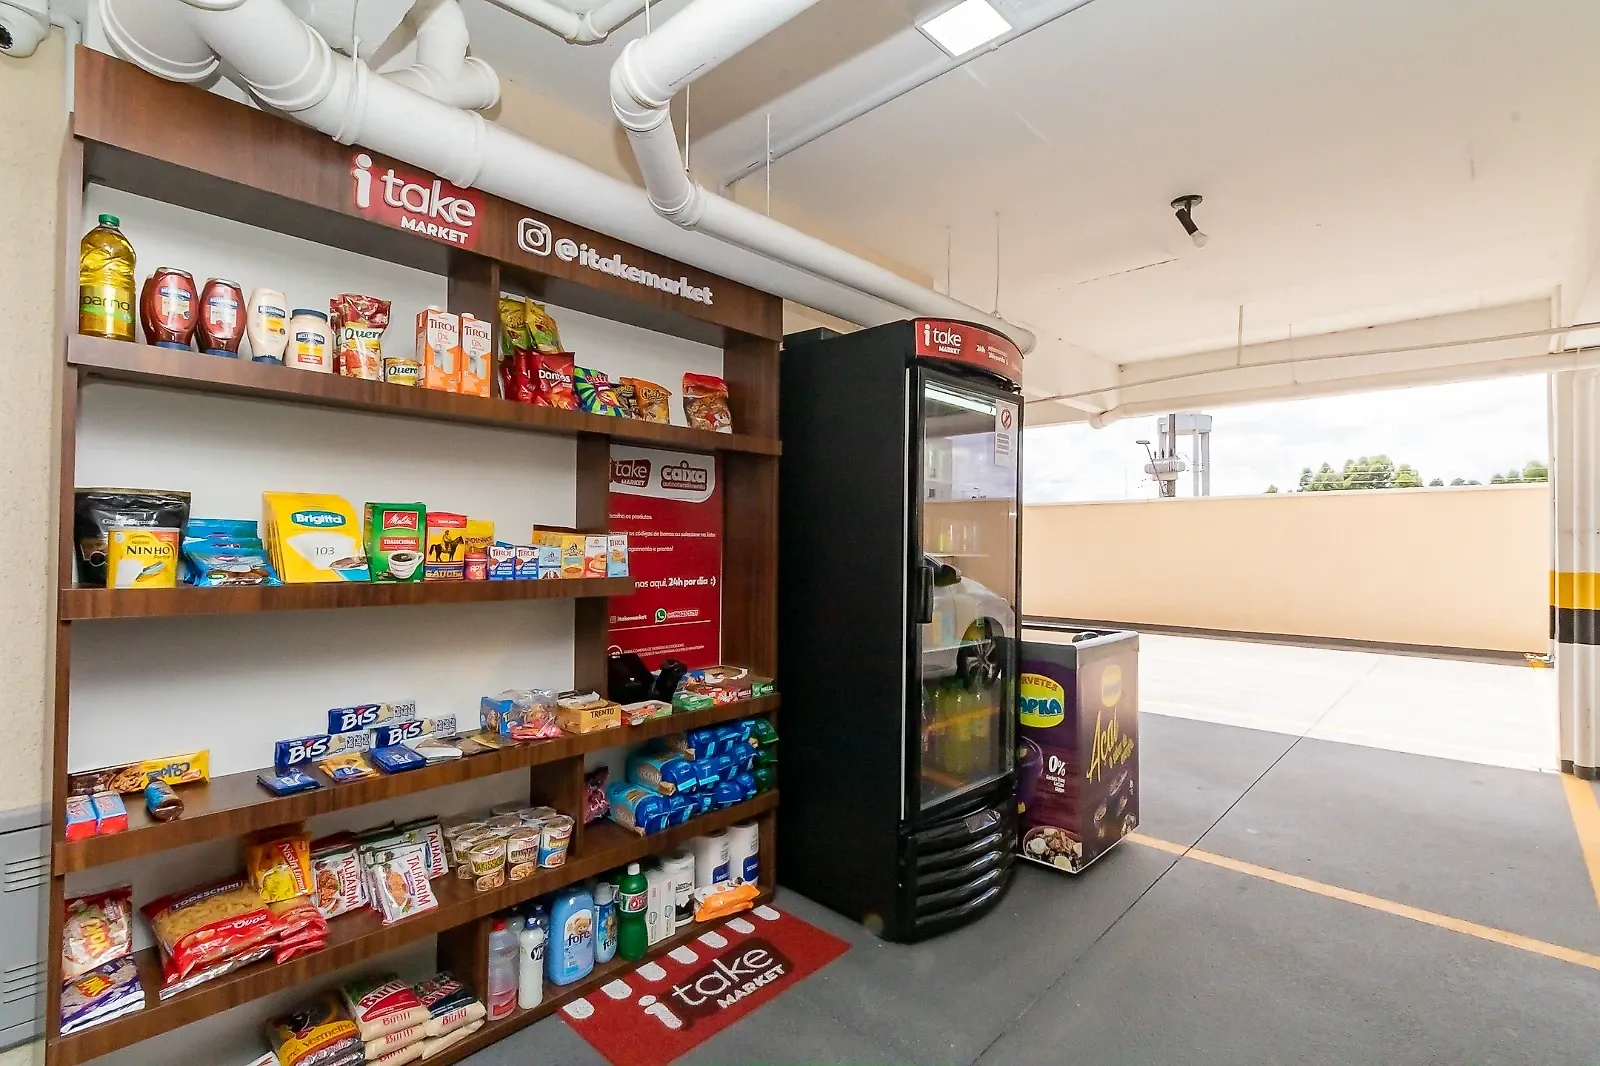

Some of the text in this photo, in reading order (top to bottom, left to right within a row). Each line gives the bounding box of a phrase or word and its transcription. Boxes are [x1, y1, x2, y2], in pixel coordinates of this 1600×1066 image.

[352, 153, 477, 227] i take
[401, 215, 468, 245] MARKET
[554, 237, 713, 305] @itakemarket
[429, 318, 458, 334] TIROL
[464, 325, 491, 341] TIROL
[923, 323, 962, 347] i take
[388, 365, 418, 376] Quero
[538, 369, 571, 384] Doritos
[614, 459, 648, 479] take
[661, 460, 707, 484] caixa
[295, 513, 343, 525] Brigitta
[126, 545, 170, 556] NINHO
[315, 546, 335, 556] 103
[383, 538, 417, 546] TRADICIONAL
[1021, 675, 1059, 692] RVETES
[590, 707, 615, 719] TRENTO
[1020, 697, 1063, 716] APKA
[1048, 755, 1066, 777] 0%
[426, 829, 443, 876] TALHARIM
[342, 855, 360, 908] TALHARIM
[407, 854, 432, 907] TALHARIM
[174, 882, 241, 909] TODESCHINI
[532, 944, 544, 961] Yp
[671, 947, 774, 1007] take
[716, 963, 786, 1010] MARKET
